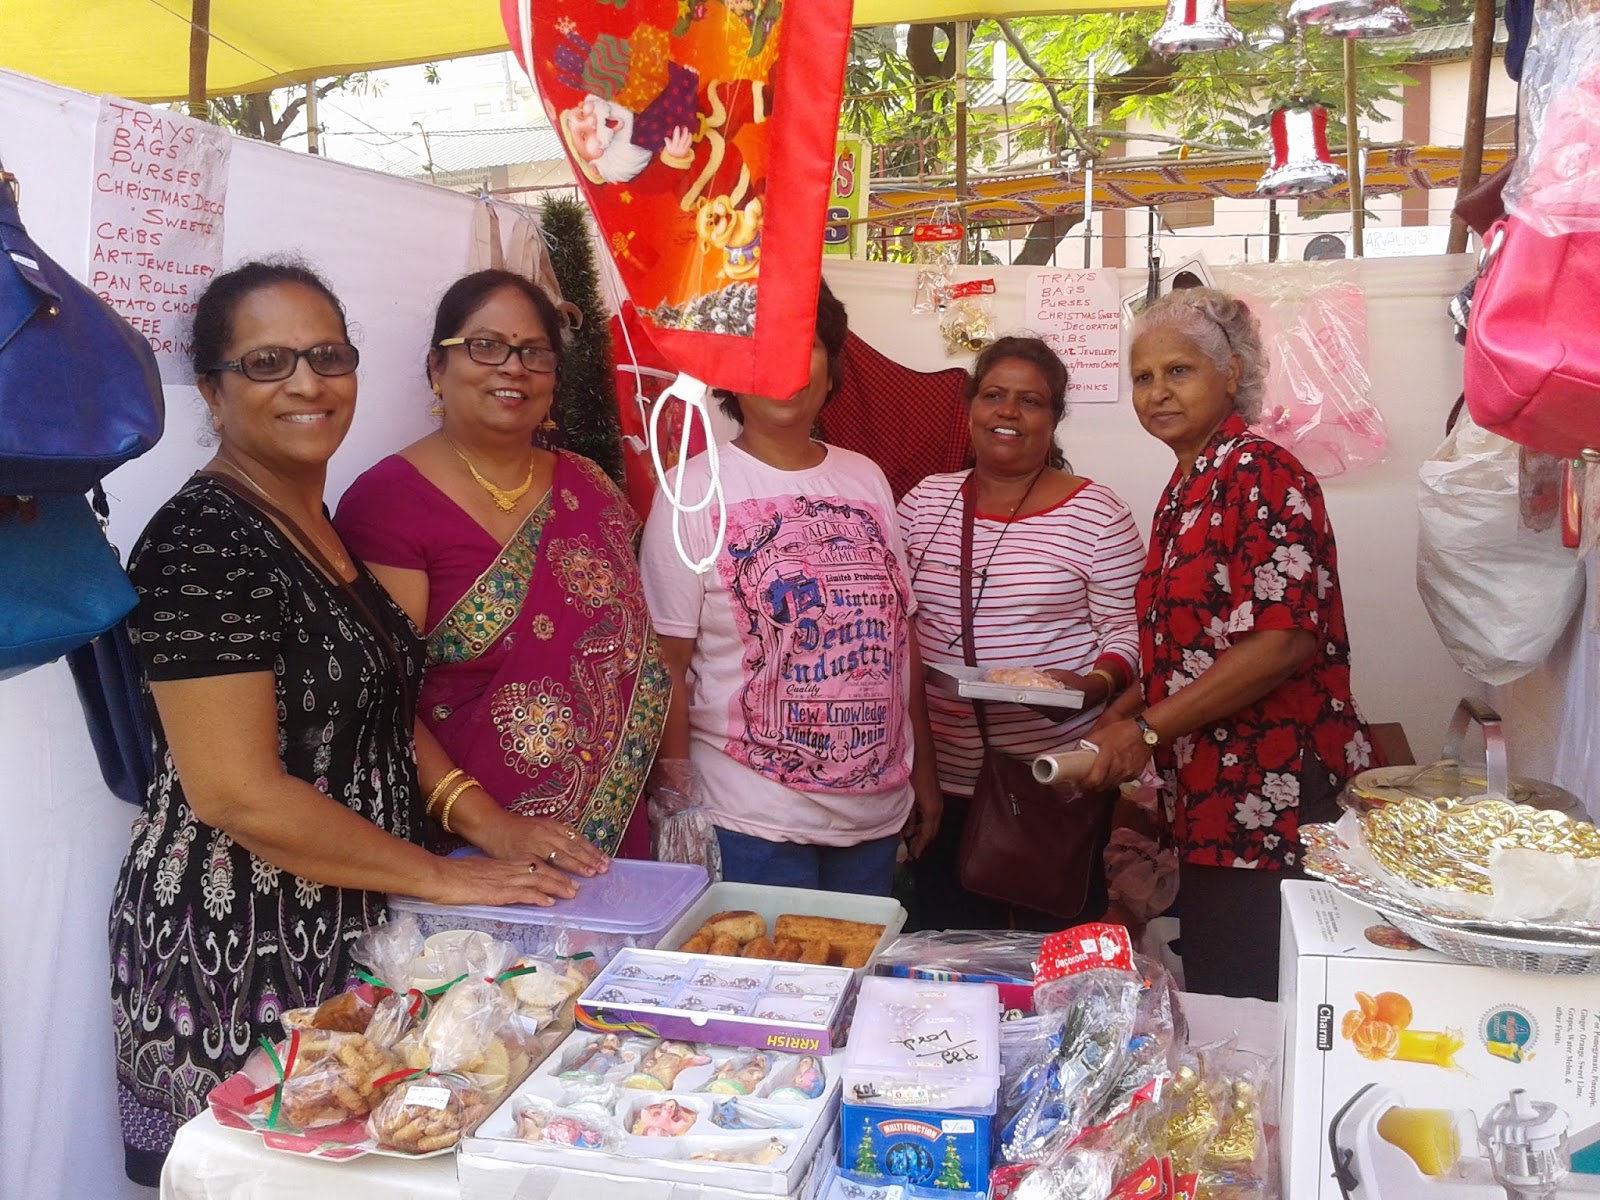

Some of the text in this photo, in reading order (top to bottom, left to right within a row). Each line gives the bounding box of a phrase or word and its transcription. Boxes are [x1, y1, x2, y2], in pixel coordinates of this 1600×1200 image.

[109, 102, 194, 145] TRAYS
[113, 127, 178, 159] BAGS
[110, 151, 201, 187] PURSES
[97, 172, 190, 209] CHRISTMAS
[142, 209, 214, 235] SWEETS
[96, 222, 162, 246] CRIBS
[136, 252, 216, 279] JEWELLERY
[93, 271, 188, 296] PAN ROLLS
[1037, 273, 1096, 284] TRAYS
[1041, 286, 1085, 298] BAGS
[1041, 299, 1090, 308] PURSES
[1038, 310, 1096, 320] CHRISTMAS
[1062, 321, 1118, 331] DECORATION
[1067, 382, 1108, 391] DRINKS
[825, 573, 852, 583] Limited
[830, 588, 895, 609] Vintage
[791, 609, 888, 652] Denim
[782, 640, 894, 683] Industry
[786, 683, 821, 698] Quality
[788, 702, 887, 723] New Knowledge
[786, 726, 885, 753] Vintage in Denim
[1318, 1006, 1331, 1048] Charmi
[767, 1034, 819, 1050] KRRISH
[904, 1123, 938, 1138] FUNCTION
